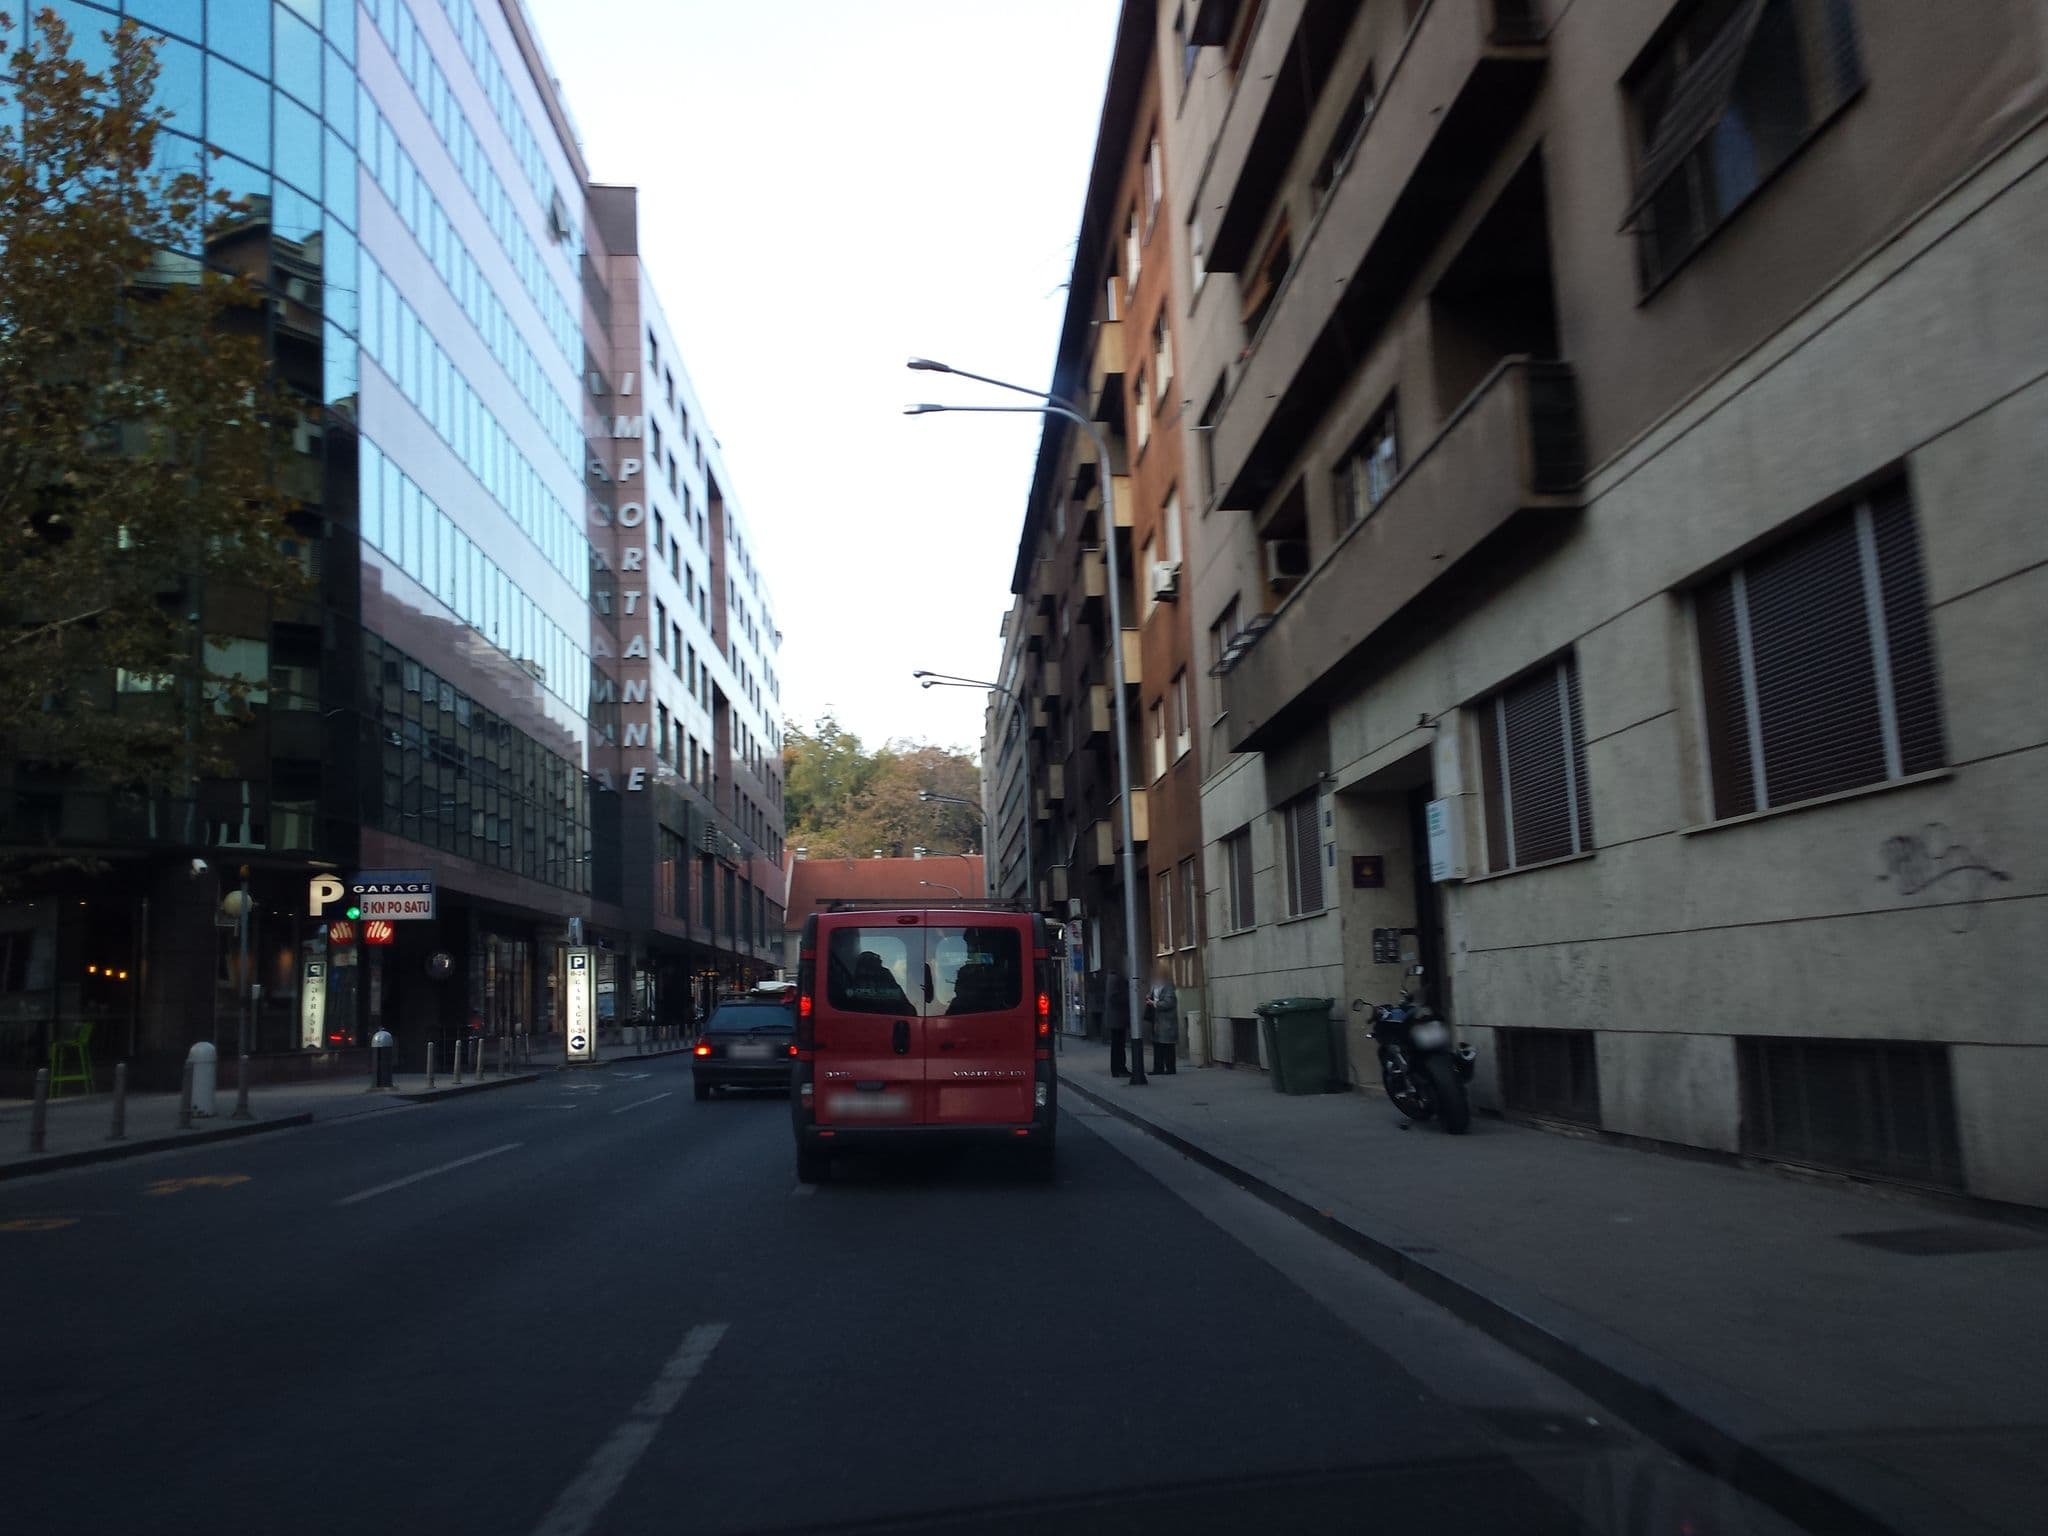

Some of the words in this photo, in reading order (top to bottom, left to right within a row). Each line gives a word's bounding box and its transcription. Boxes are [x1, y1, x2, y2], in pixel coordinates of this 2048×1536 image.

[614, 371, 648, 792] IMPORTANNE
[352, 884, 431, 894] GARAGE
[309, 880, 345, 917] P
[362, 902, 369, 914] 5
[371, 902, 385, 914] KN
[388, 901, 402, 913] PO
[404, 900, 430, 913] SATU
[366, 920, 392, 943] illy
[573, 957, 583, 968] P
